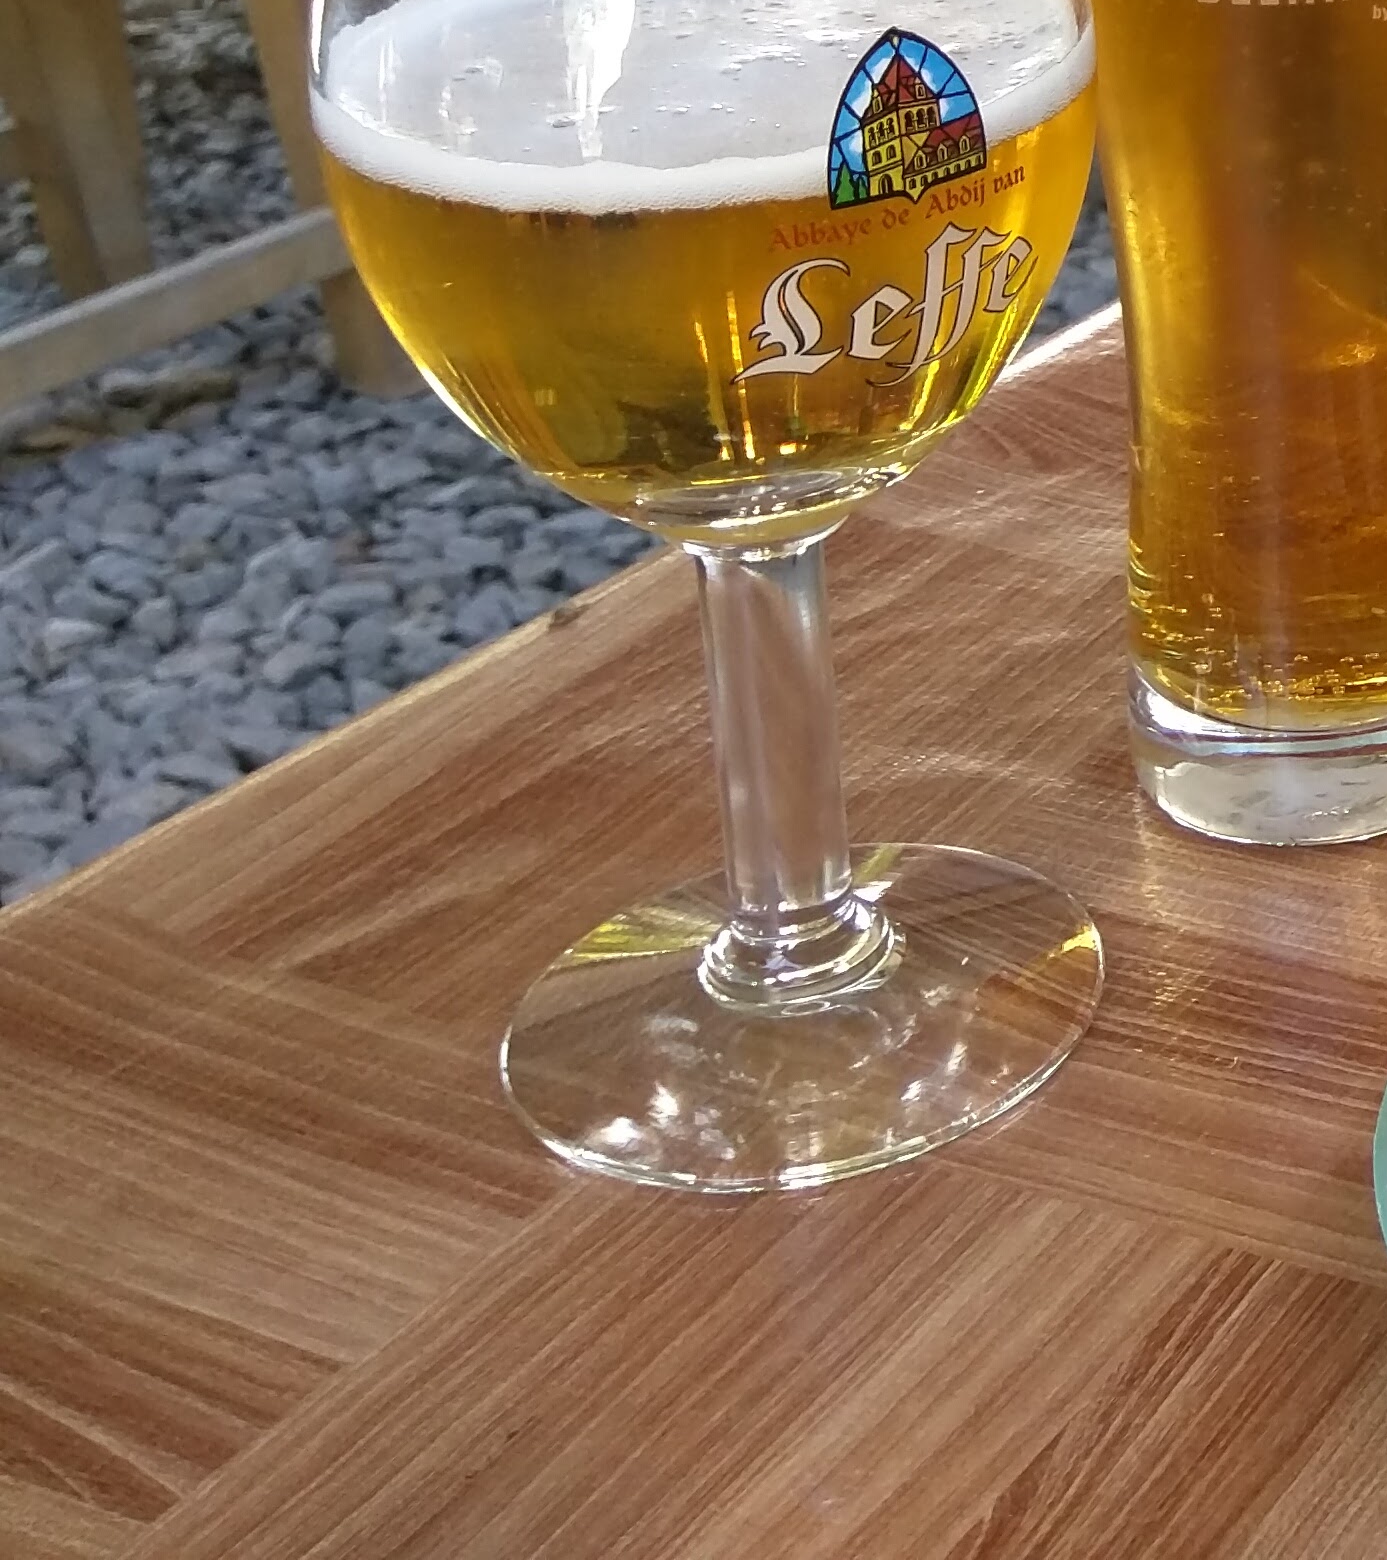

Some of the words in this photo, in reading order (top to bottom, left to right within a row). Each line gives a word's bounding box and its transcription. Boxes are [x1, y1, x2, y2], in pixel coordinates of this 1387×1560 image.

[769, 213, 873, 253] Abbaye
[881, 206, 911, 230] de
[924, 178, 987, 220] Abdij
[729, 221, 1040, 388] Leffe
